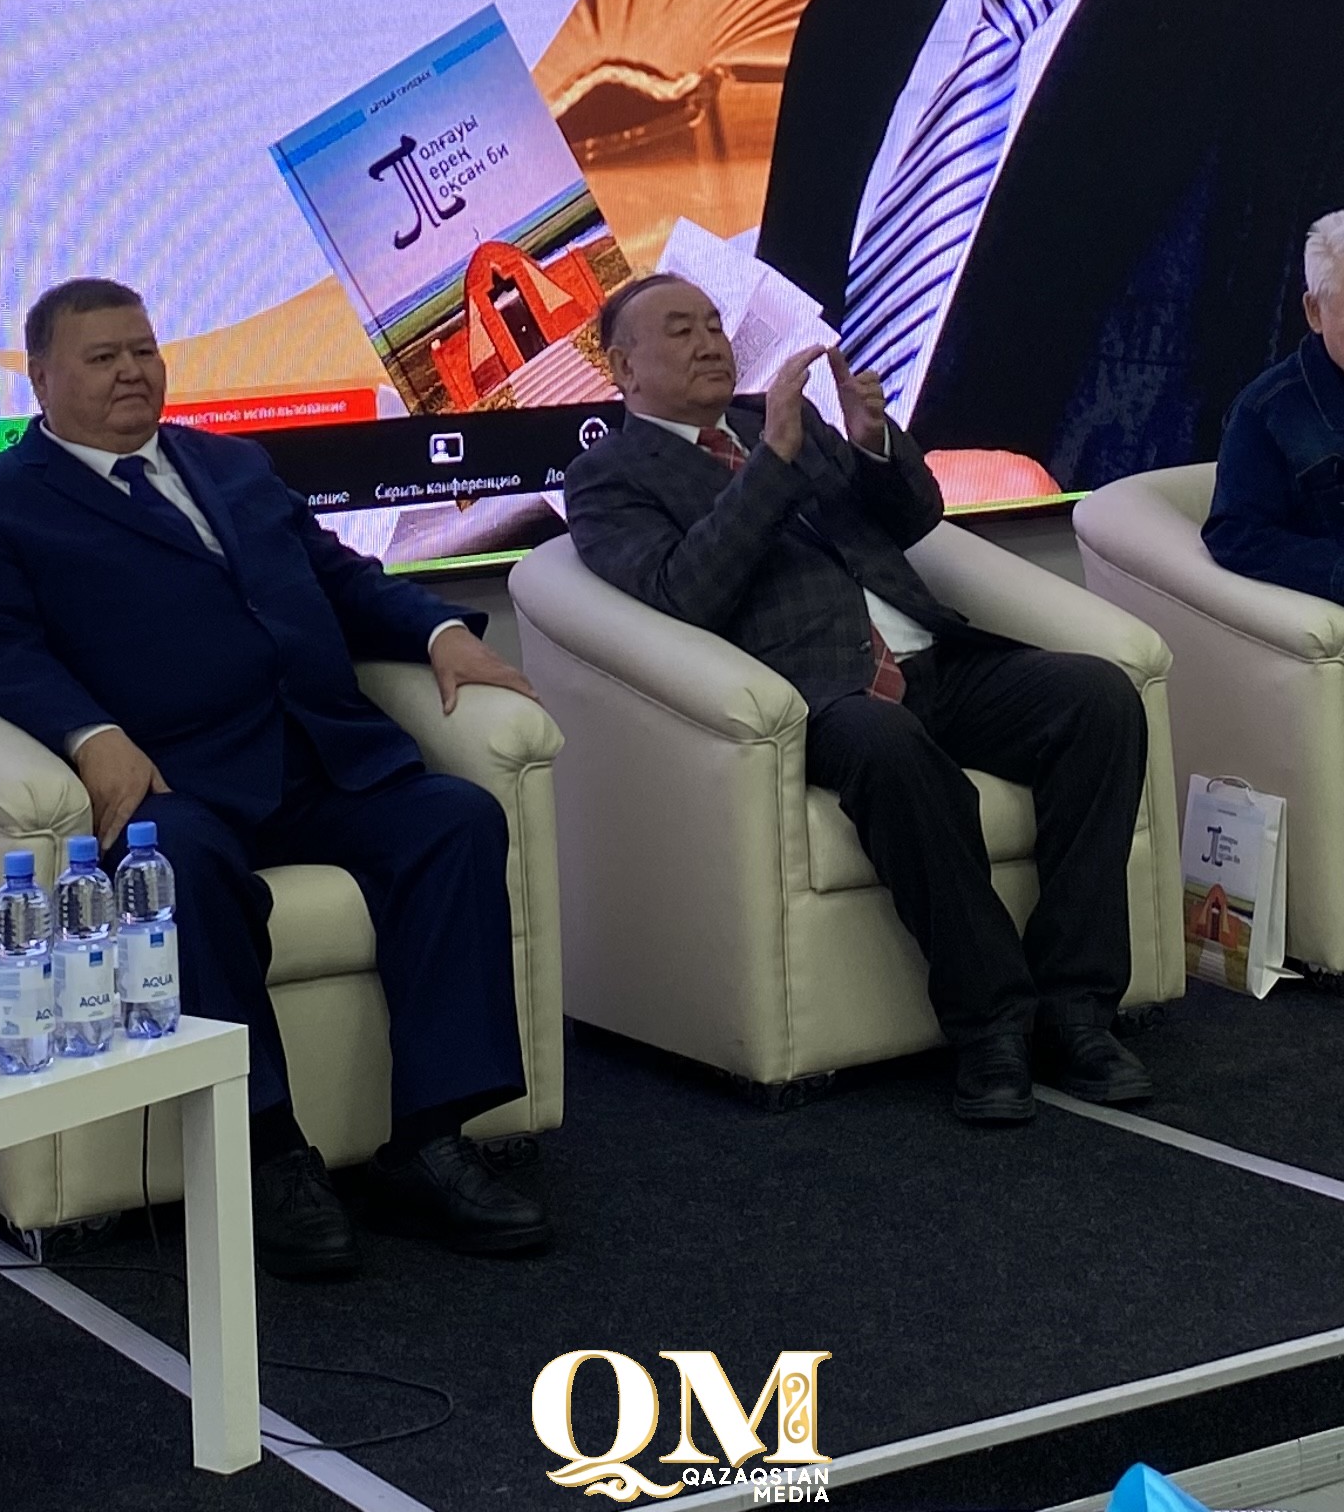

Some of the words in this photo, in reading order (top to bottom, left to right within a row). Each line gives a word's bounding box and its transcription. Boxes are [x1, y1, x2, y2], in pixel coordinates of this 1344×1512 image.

[374, 483, 424, 502] Скрыть
[426, 474, 522, 497] конференцию
[142, 973, 174, 989] AQUA
[79, 993, 110, 1008] AQUA
